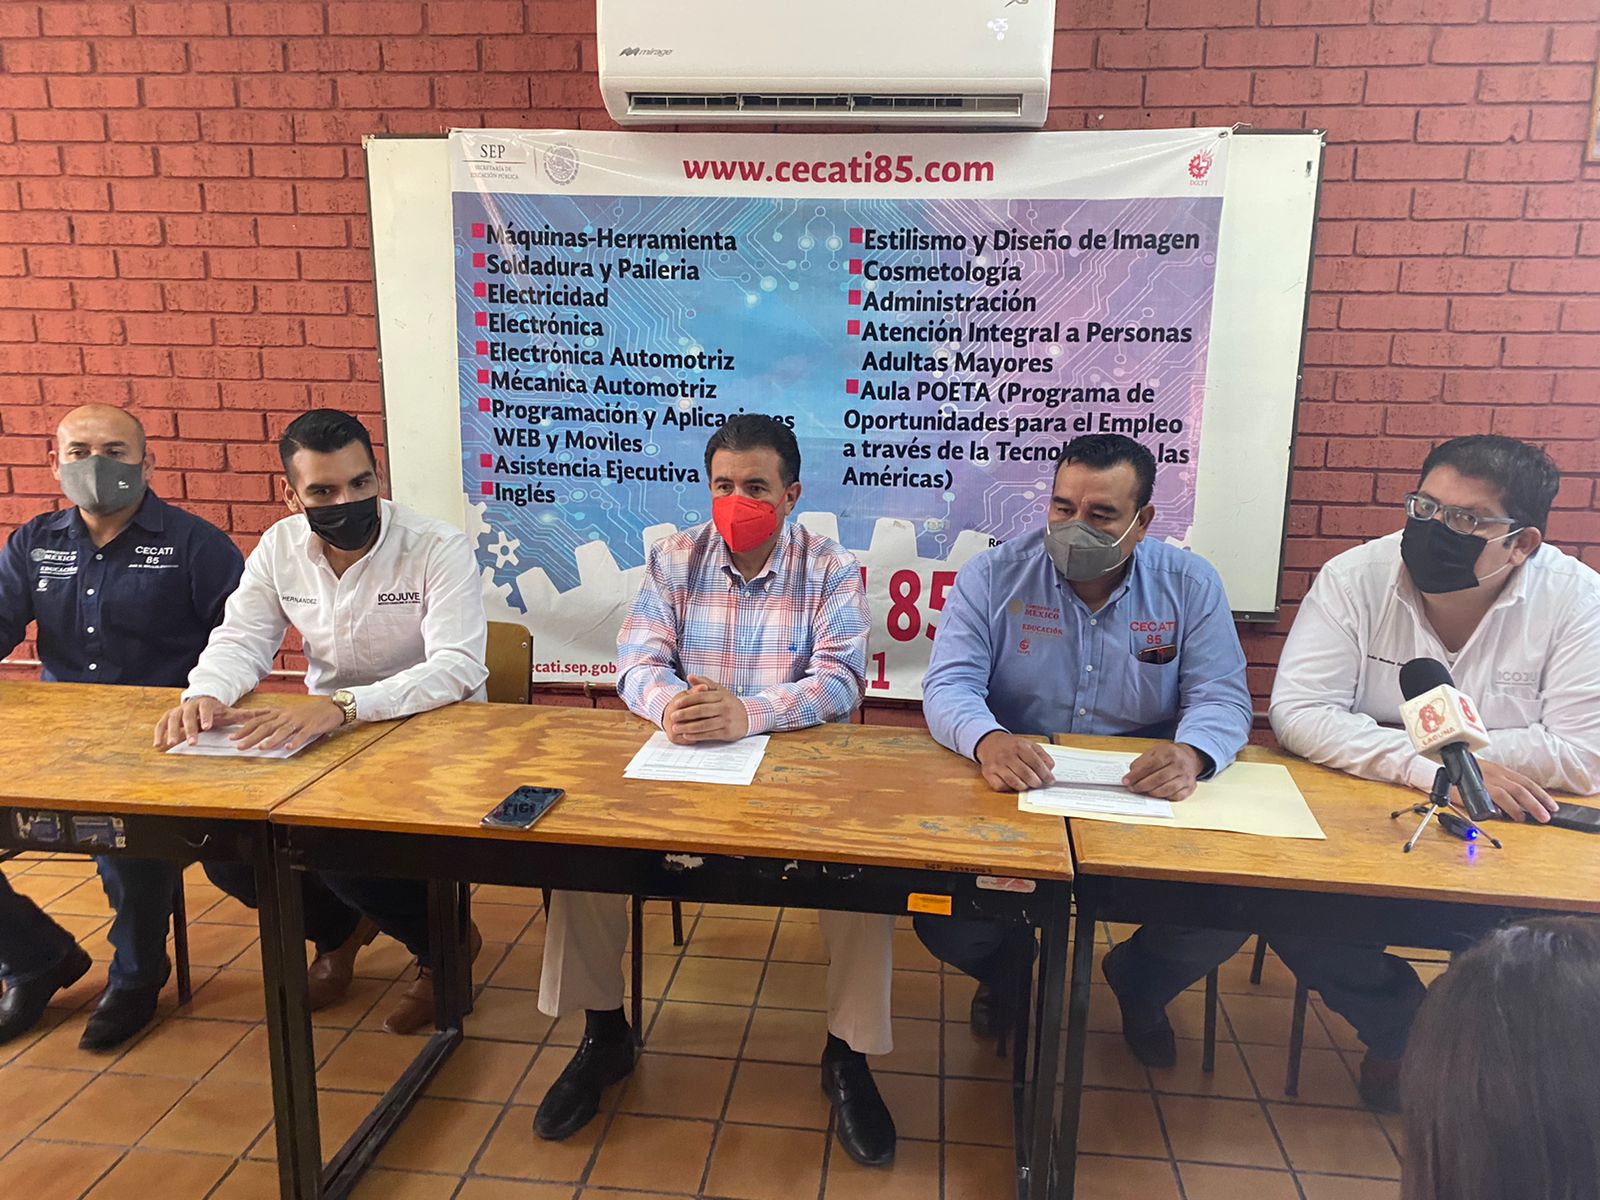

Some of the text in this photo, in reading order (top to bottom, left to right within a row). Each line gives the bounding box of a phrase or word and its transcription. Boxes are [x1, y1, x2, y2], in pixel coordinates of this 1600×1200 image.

[480, 144, 506, 159] SEP
[682, 151, 994, 184] www.cecati85.com
[486, 222, 738, 252] Máquinas-Herramienta
[864, 227, 1200, 256] Estilismo y Diseño de Imagen
[487, 254, 700, 283] Soldadura y Paileria
[863, 258, 1022, 285] Cosmetología
[488, 284, 609, 308] Electricidad
[862, 287, 1037, 312] Administración
[488, 312, 604, 337] Electrónica
[861, 320, 1192, 348] Atención Integral a Personas
[489, 342, 735, 371] Electrónica Automotriz
[861, 351, 1053, 378] Adultas Mayores
[491, 371, 717, 399] Mécanica Automotriz
[860, 380, 1155, 408] Aula POETA (Programa de
[492, 400, 639, 427] Programación
[643, 408, 656, 430] y
[844, 410, 1183, 438] Oportunidades para el Empleo
[493, 428, 643, 453] WEB y Moviles
[843, 442, 856, 458] a
[862, 438, 931, 459] través
[937, 438, 964, 460] de
[970, 439, 990, 461] la
[1157, 443, 1190, 464] las
[494, 455, 700, 483] Asistencia Ejecutiva
[842, 466, 954, 490] Américas)
[494, 482, 556, 506] Inglés
[135, 546, 174, 555] CECATI
[146, 556, 160, 565] 85
[378, 592, 420, 602] ICOJUVE
[1130, 621, 1177, 632] CECAT
[1146, 634, 1162, 645] 85
[1422, 726, 1457, 746] LAGUNA
